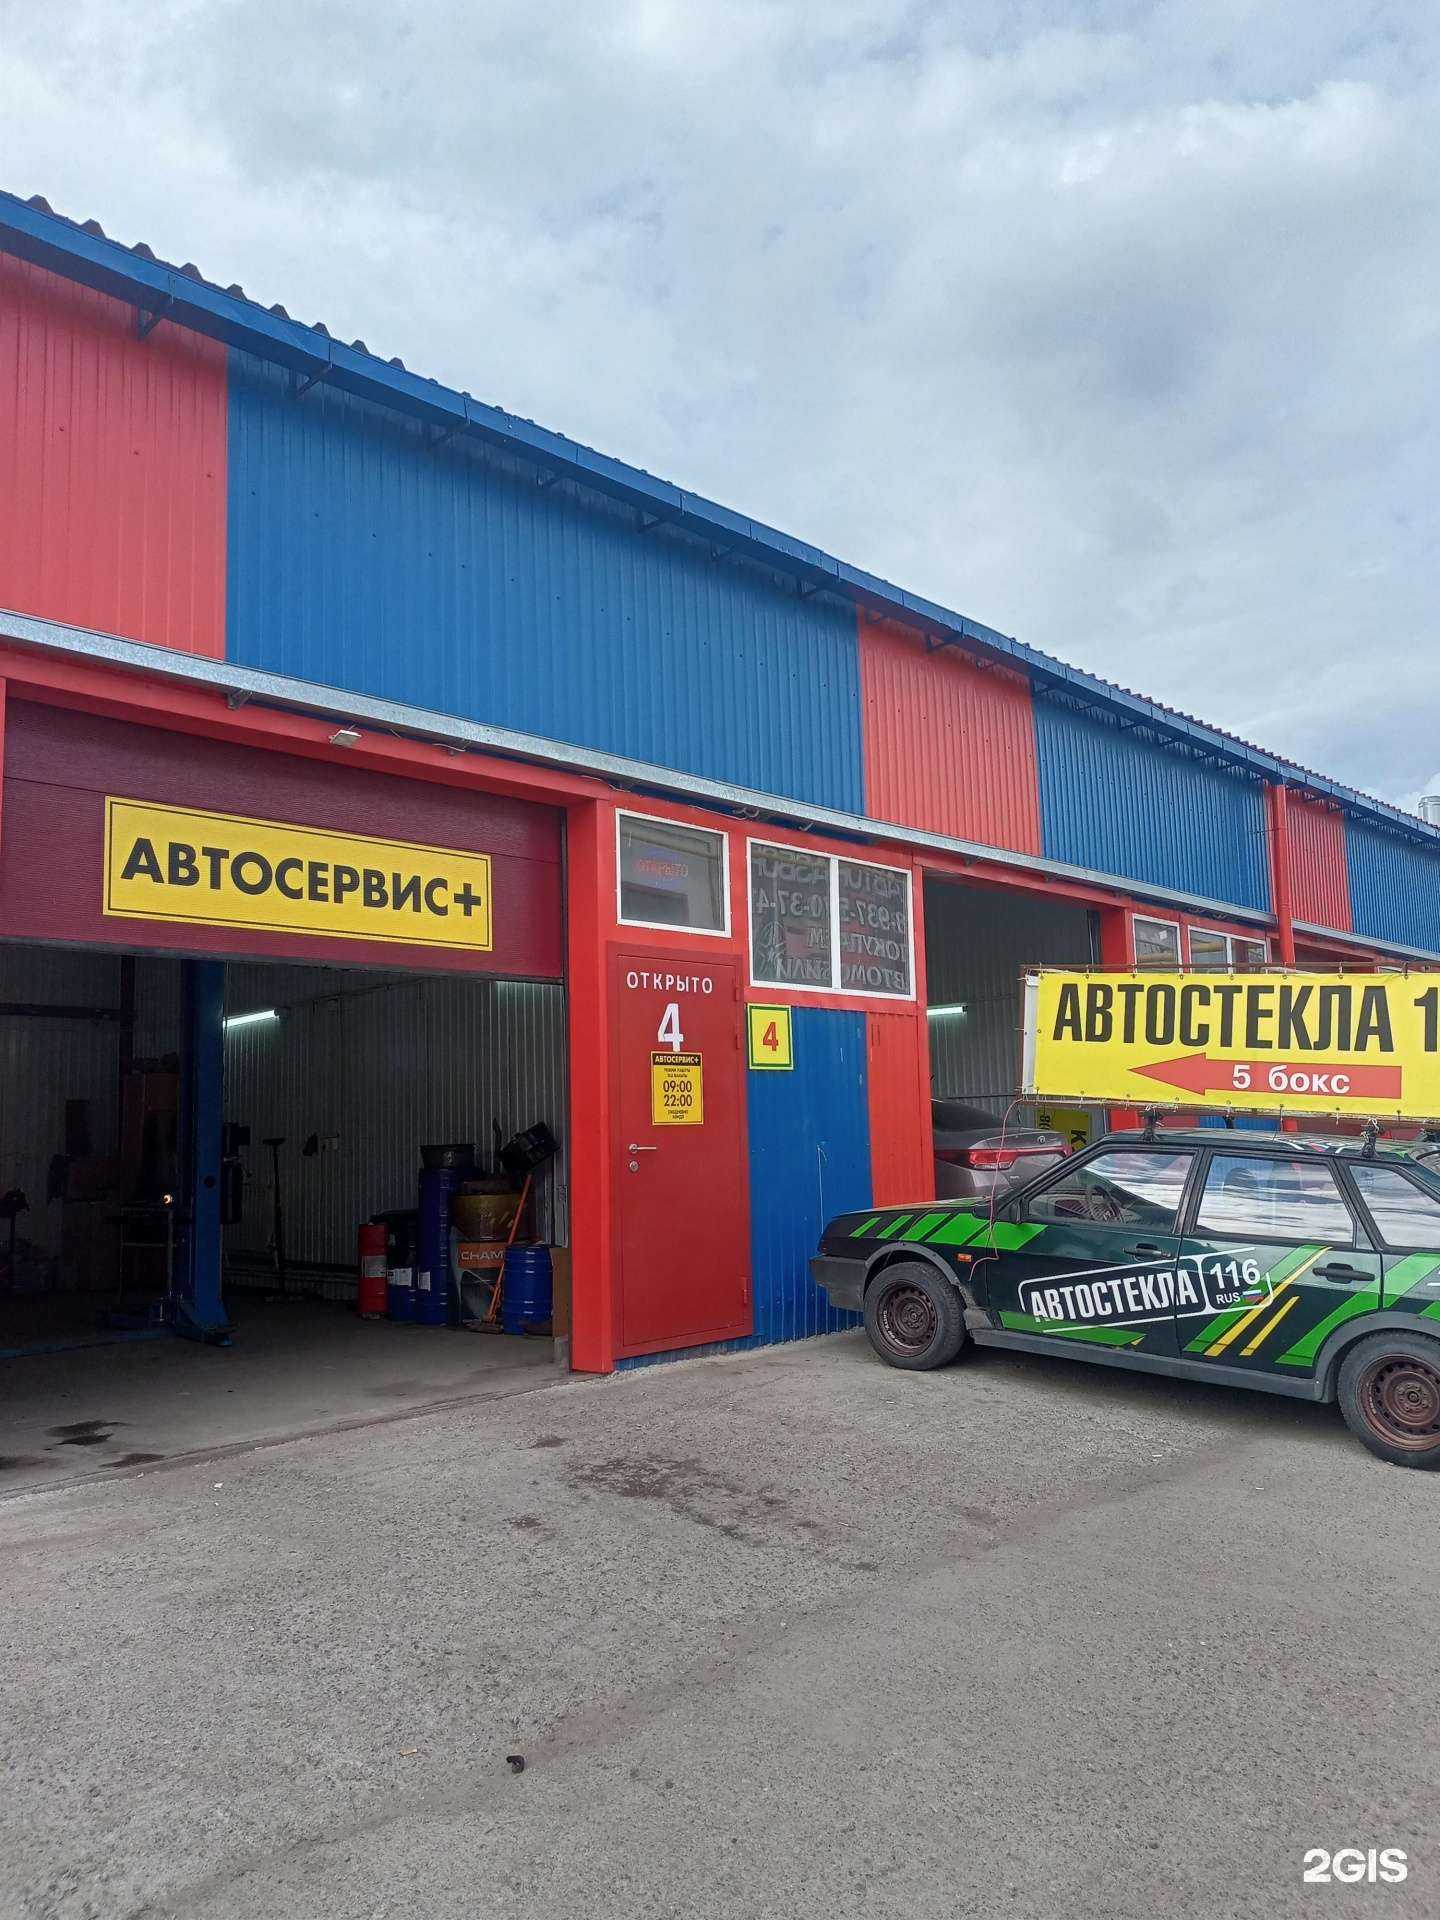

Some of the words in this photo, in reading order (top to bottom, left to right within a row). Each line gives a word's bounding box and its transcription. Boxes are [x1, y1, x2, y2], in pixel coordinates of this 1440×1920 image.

[120, 838, 481, 917] АВТОСЕРВИС+
[626, 971, 713, 994] ОТКРЫТО
[657, 1003, 684, 1052] 4
[1052, 983, 1395, 1053] АВТОСТЕКЛА
[762, 1021, 779, 1052] 4
[663, 1080, 693, 1093] 09:00
[1232, 1064, 1252, 1090] 5
[1268, 1065, 1351, 1095] бокс
[663, 1094, 693, 1107] 22:00
[1209, 1258, 1261, 1290] 116
[1030, 1269, 1199, 1322] АВТОСТЕКЛА
[1215, 1291, 1241, 1305] RUS
